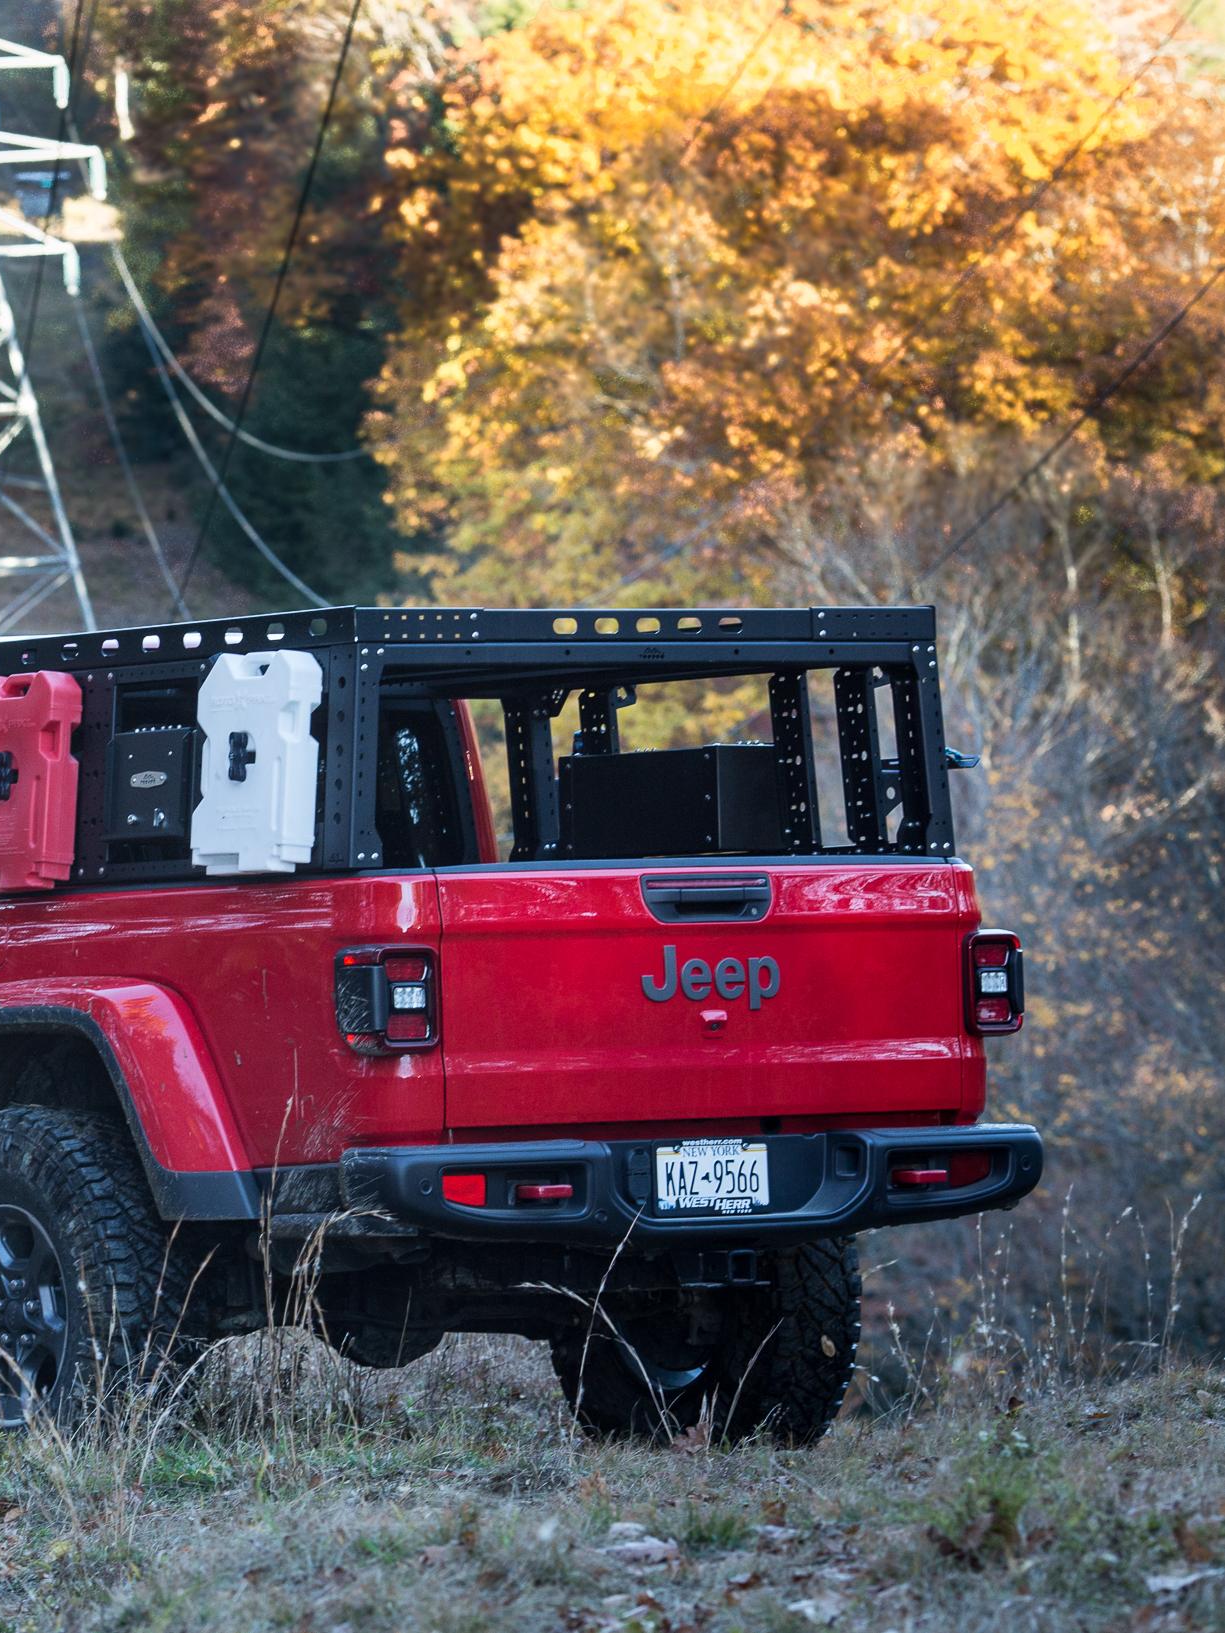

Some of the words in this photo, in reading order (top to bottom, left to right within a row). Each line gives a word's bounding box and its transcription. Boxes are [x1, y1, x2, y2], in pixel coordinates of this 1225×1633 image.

[642, 945, 780, 1010] Jeep
[682, 1147, 707, 1157] NEW
[709, 1145, 741, 1156] YORK
[665, 1161, 700, 1196] KAZ
[714, 1159, 760, 1194] 9566
